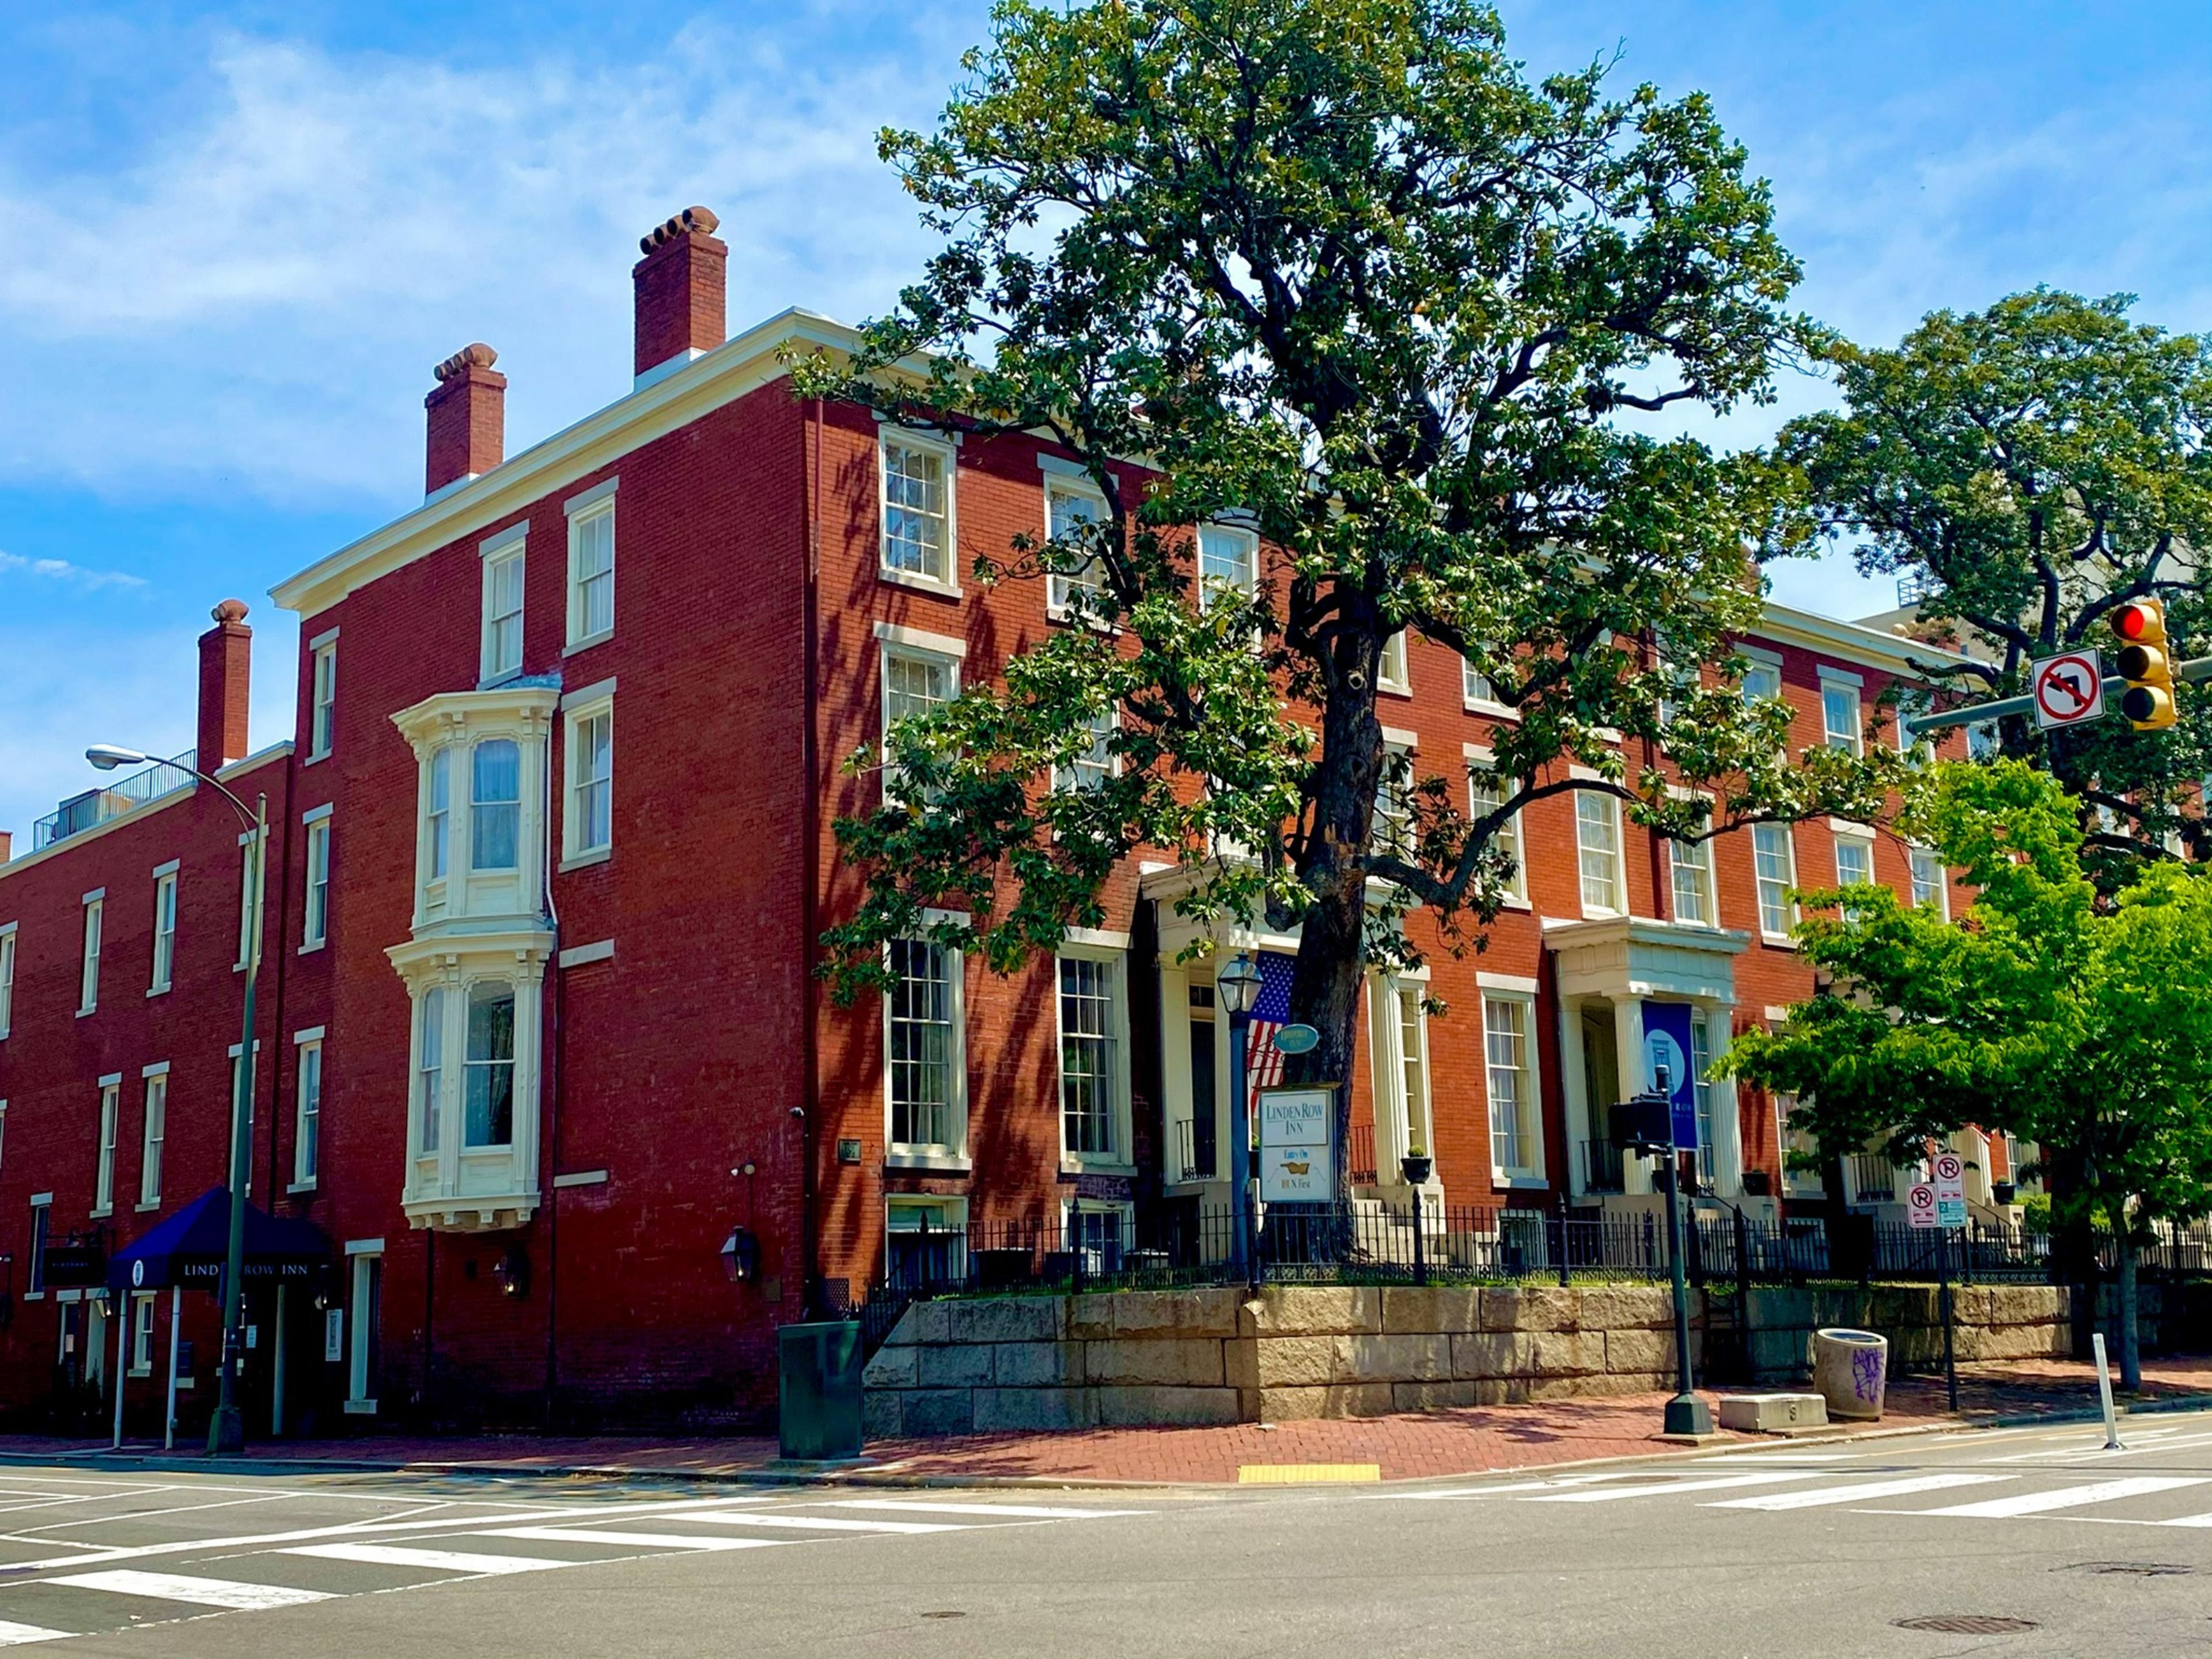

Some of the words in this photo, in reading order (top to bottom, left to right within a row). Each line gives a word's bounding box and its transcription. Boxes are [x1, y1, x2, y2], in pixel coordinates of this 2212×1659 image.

[1266, 1104, 1300, 1120] LINDEN
[1302, 1103, 1323, 1118] ROW
[1286, 1120, 1303, 1135] INN
[184, 1264, 219, 1276] LIND
[244, 1265, 274, 1275] ROW
[282, 1264, 307, 1275] INN
